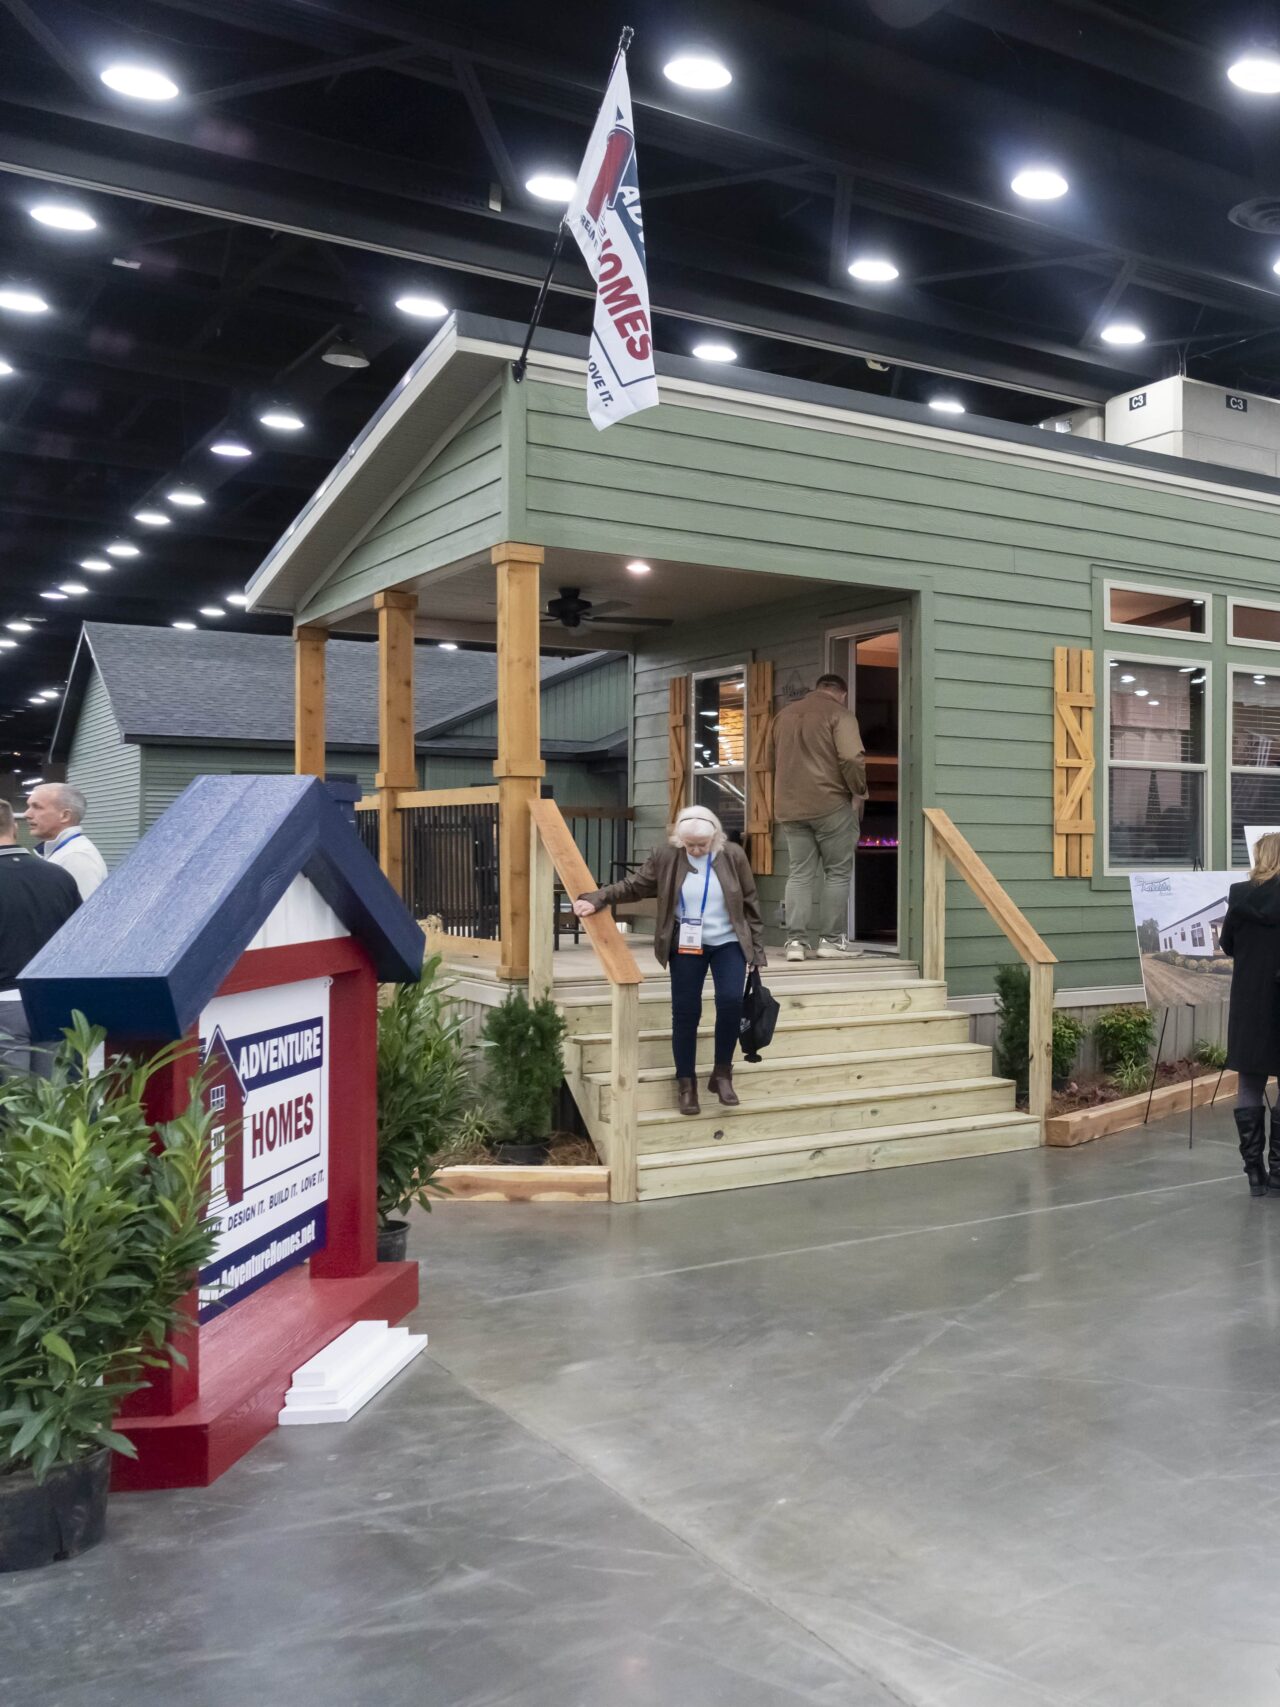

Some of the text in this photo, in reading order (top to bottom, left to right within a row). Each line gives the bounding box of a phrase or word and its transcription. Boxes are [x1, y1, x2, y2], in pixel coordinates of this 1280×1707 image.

[589, 355, 614, 408] OVE IT.
[1131, 395, 1144, 408] C3
[1229, 397, 1244, 410] C3
[238, 1025, 321, 1081] ADVENTURE
[252, 1092, 314, 1160] HOMES
[227, 1203, 256, 1231] DESIGN
[257, 1200, 266, 1214] IT.
[269, 1187, 290, 1210] BUILD
[301, 1172, 316, 1192] LOVE
[317, 1169, 325, 1184] IT.
[198, 1219, 316, 1312] ww.AdventureHomes.net
